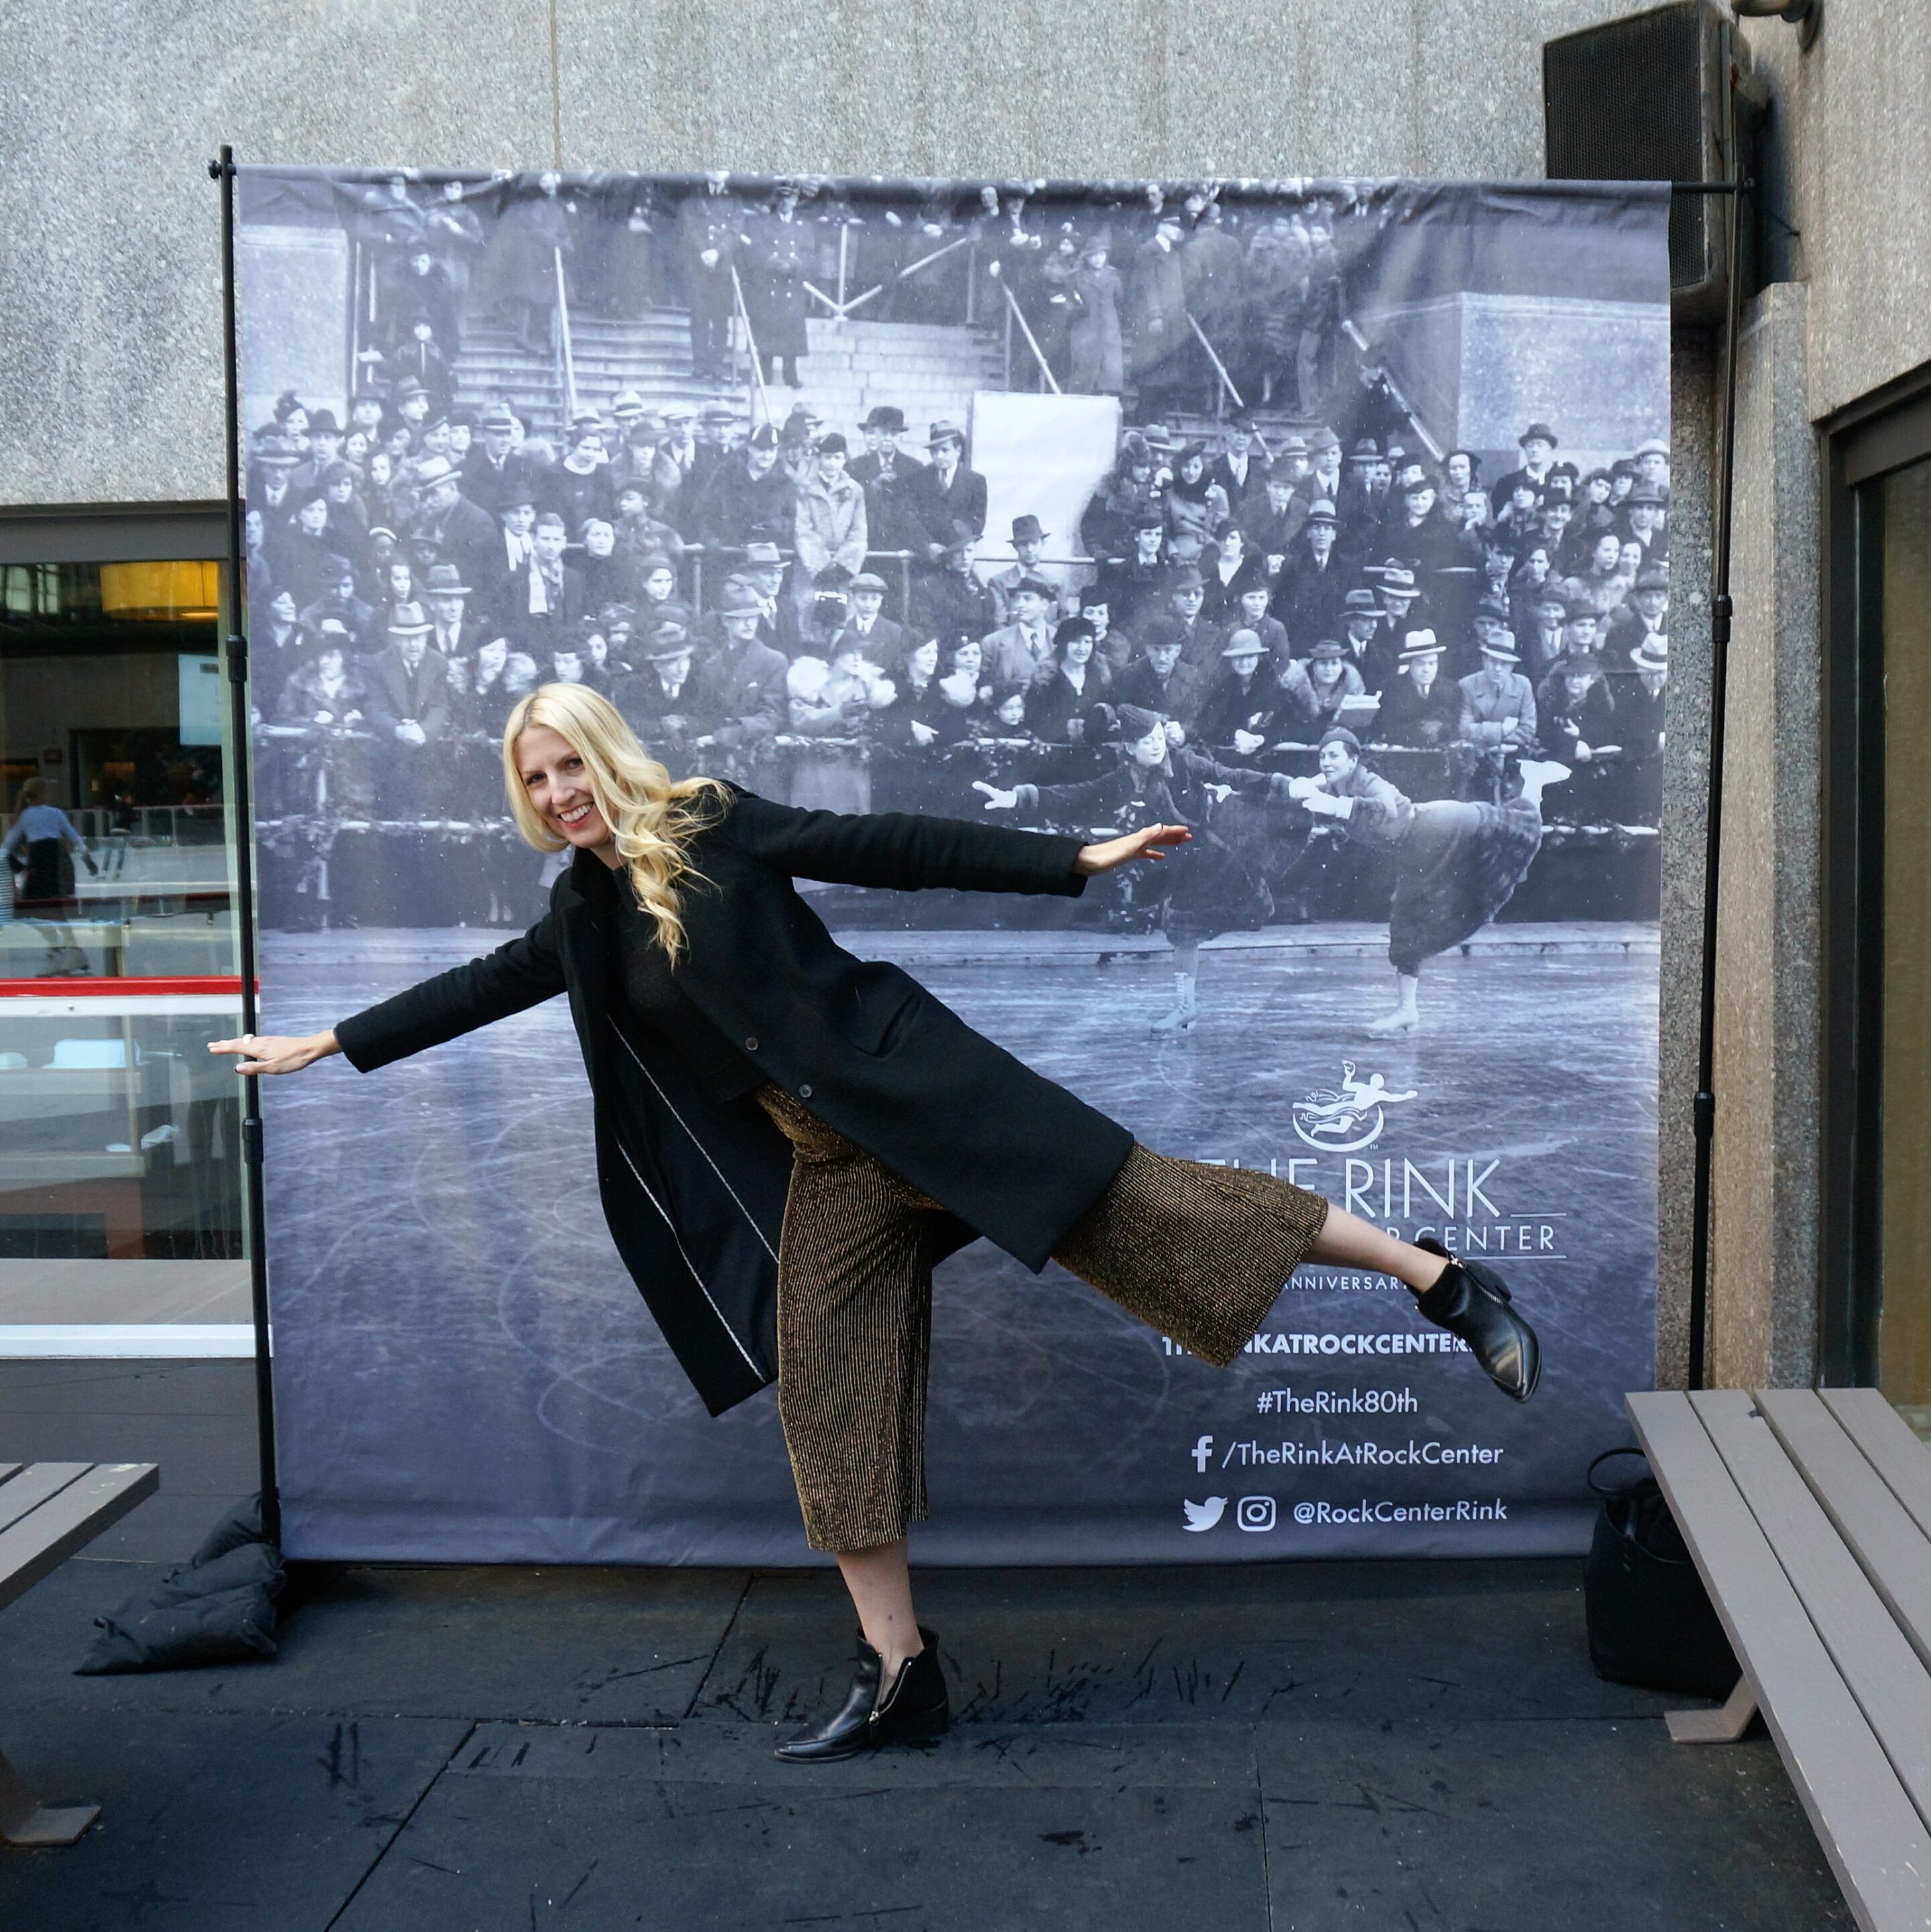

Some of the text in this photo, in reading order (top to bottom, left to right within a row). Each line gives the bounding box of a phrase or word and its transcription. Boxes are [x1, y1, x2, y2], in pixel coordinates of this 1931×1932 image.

[1345, 1157, 1501, 1219] RINK
[1283, 1276, 1407, 1290] NNIVERSAR
[1256, 1387, 1418, 1414] #TheRink80th
[1222, 1440, 1504, 1469] /TheRinkAtRockCenter
[1293, 1498, 1508, 1524] @RockCenterRink
